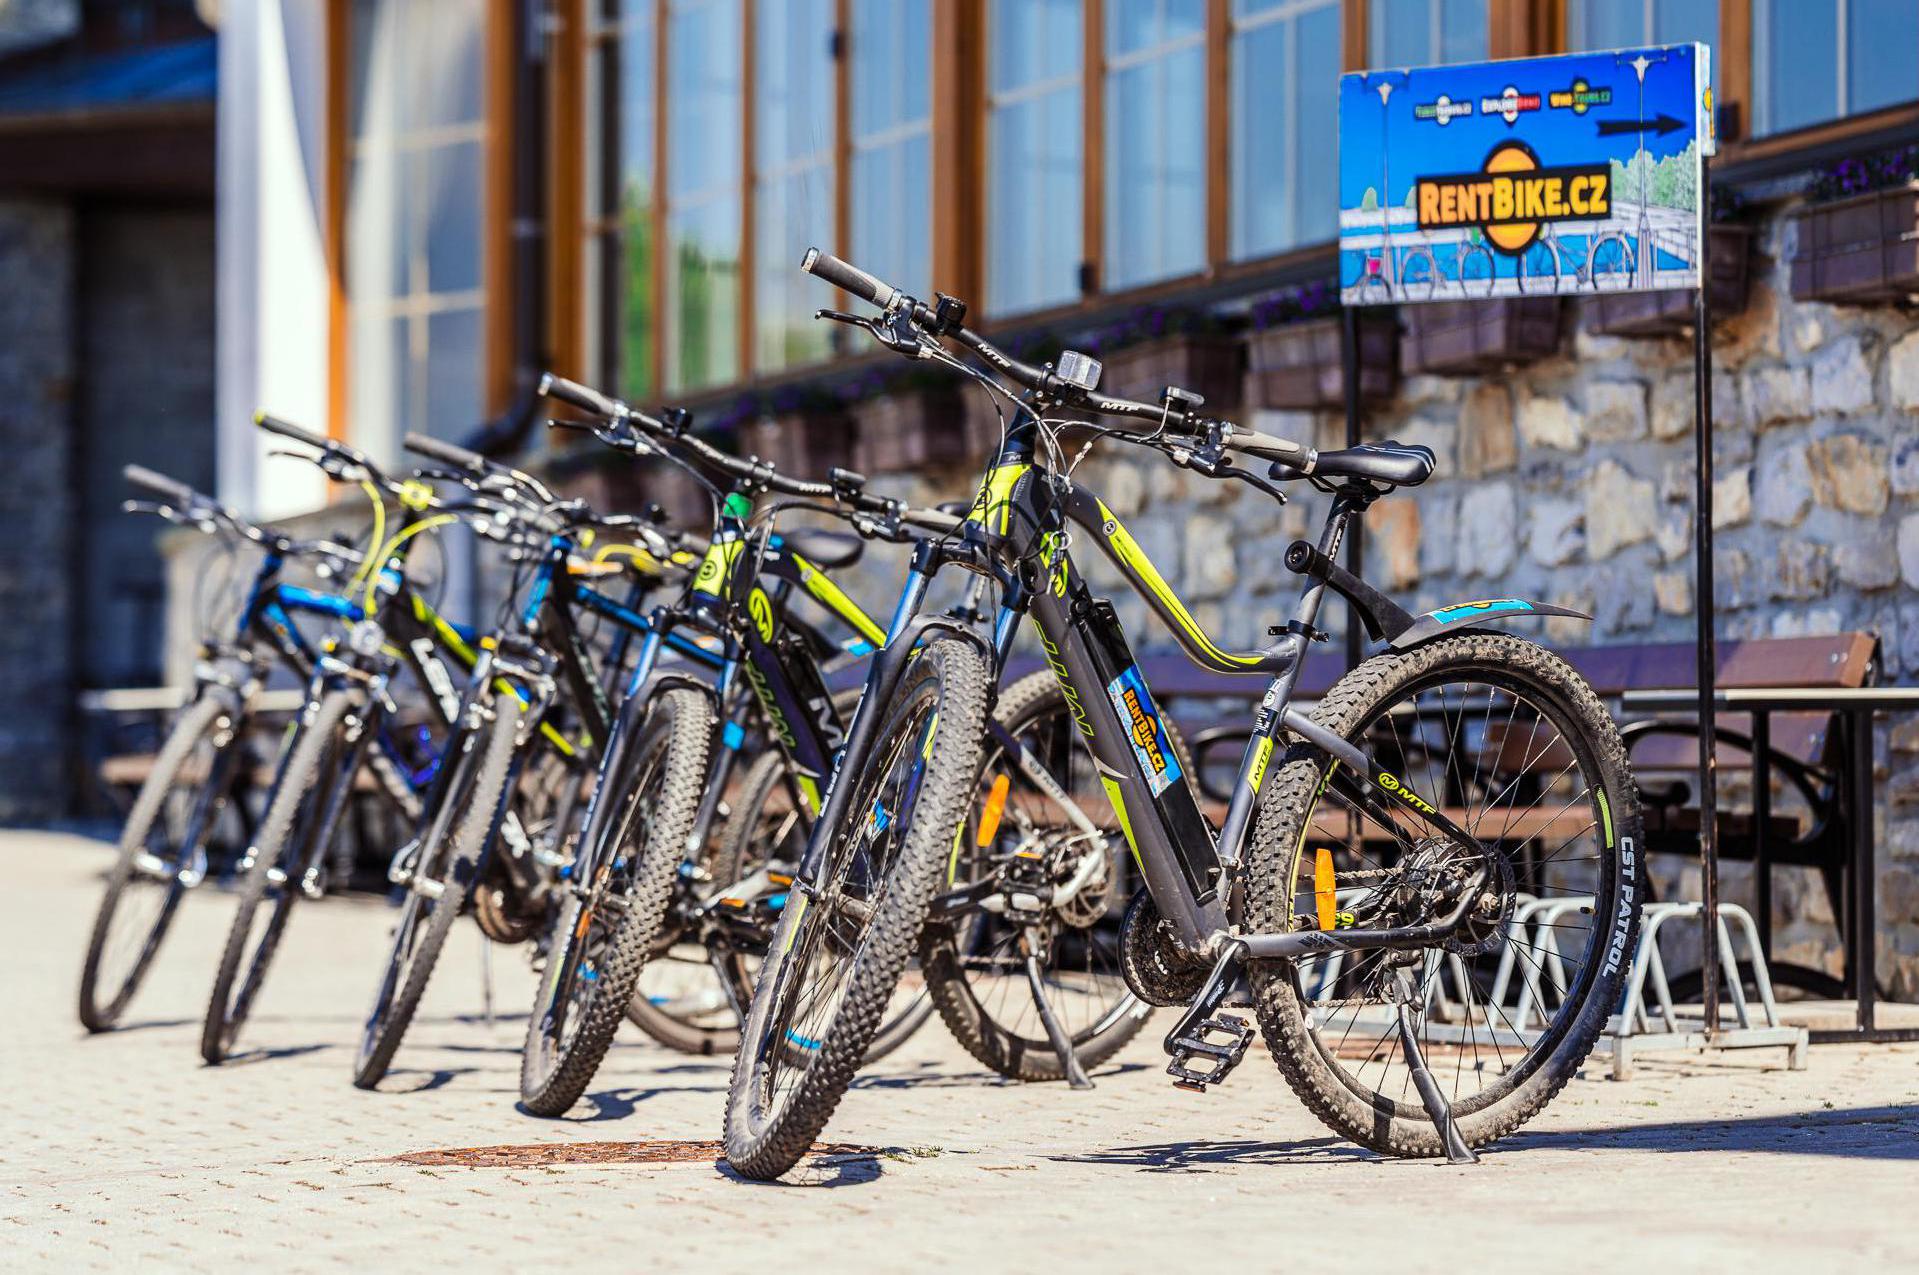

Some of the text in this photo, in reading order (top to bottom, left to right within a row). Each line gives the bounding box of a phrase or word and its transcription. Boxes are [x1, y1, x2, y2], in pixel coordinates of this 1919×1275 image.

[1419, 174, 1608, 226] RENTBIKE.CZ
[977, 342, 1012, 368] MTF
[1099, 400, 1141, 413] MTF
[1123, 688, 1166, 774] RENTBIKE.CZ
[1398, 787, 1437, 814] MTF
[1601, 836, 1636, 978] CST PATROL
